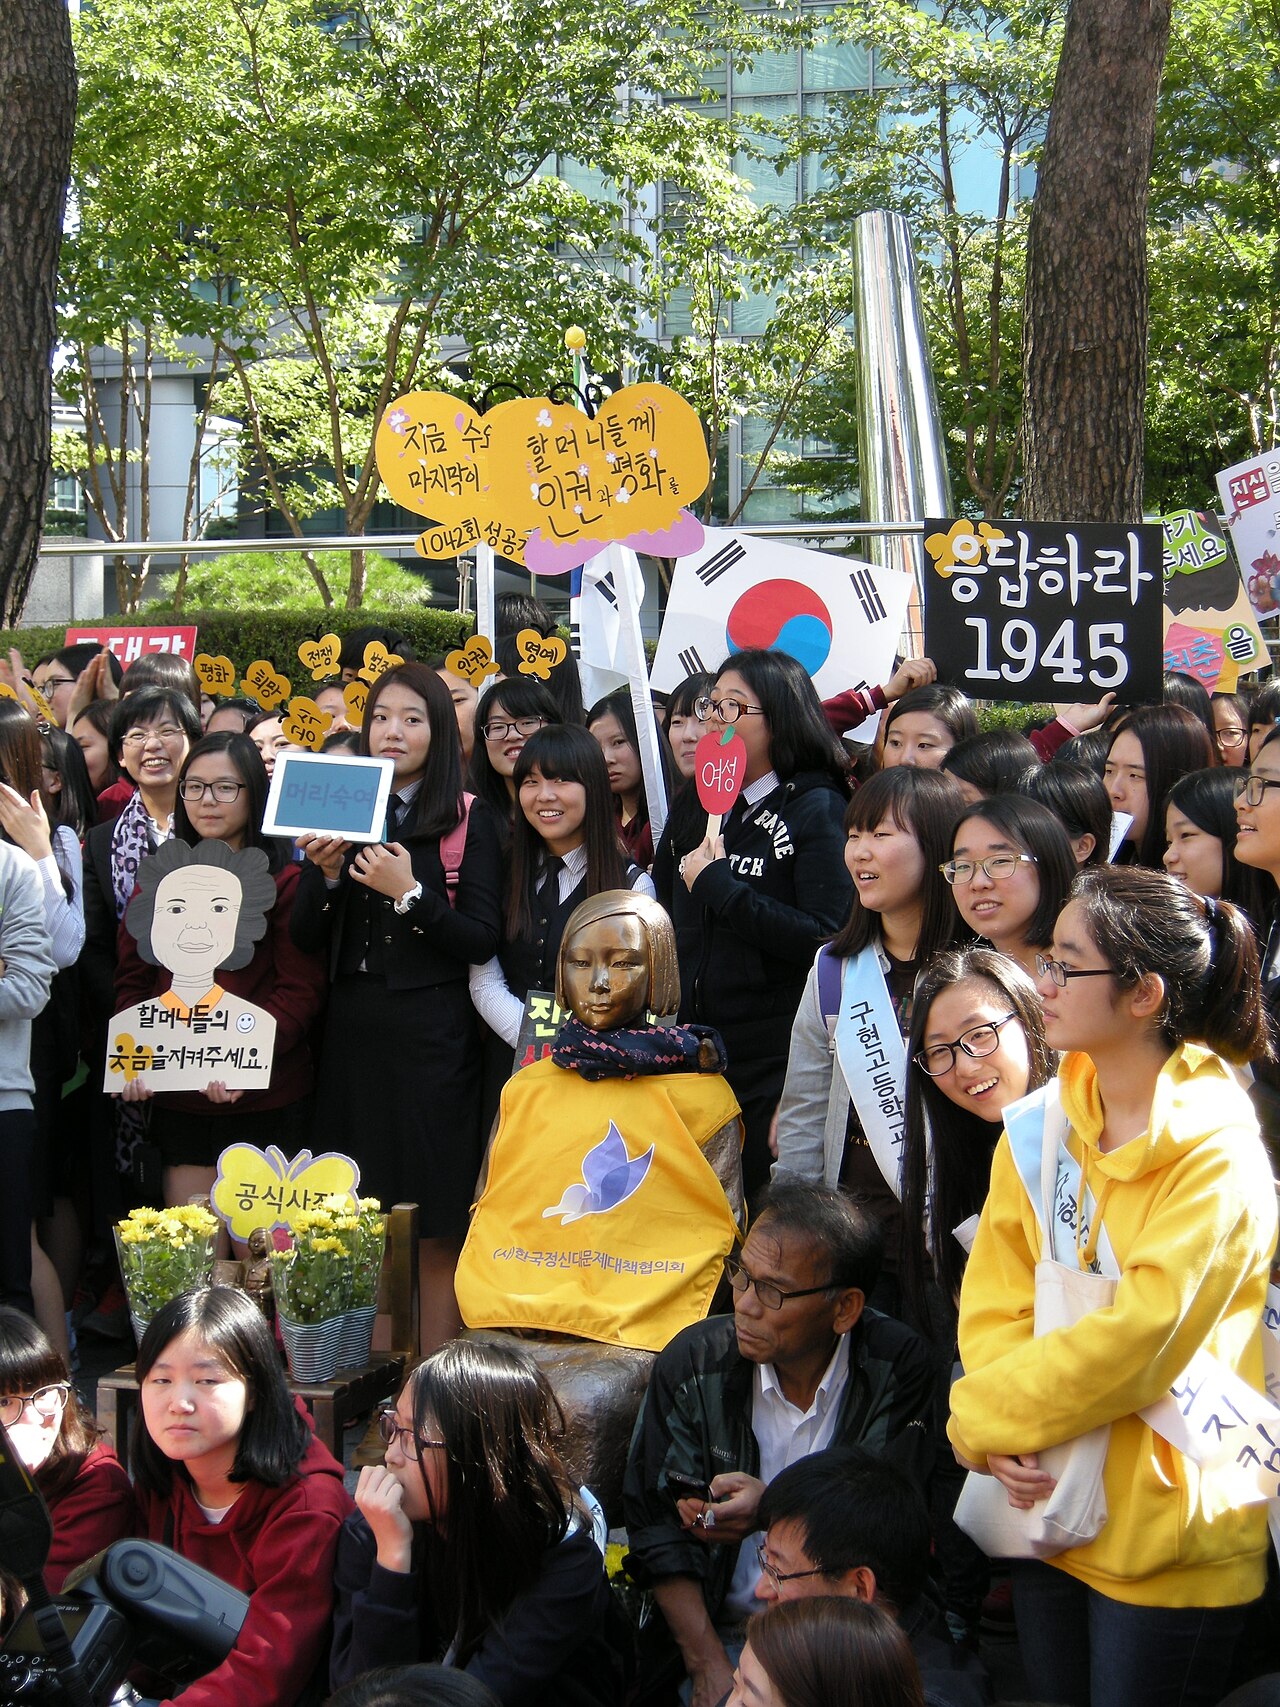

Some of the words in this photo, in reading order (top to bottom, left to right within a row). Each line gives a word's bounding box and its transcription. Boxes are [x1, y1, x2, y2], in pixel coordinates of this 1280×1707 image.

[403, 421, 447, 455] 지금
[944, 531, 1153, 608] 응답하라
[307, 644, 333, 669] 전쟁
[457, 647, 489, 676] 인권
[524, 641, 559, 664] 명예
[964, 617, 1129, 688] 1945
[199, 663, 230, 683] 평화
[250, 668, 282, 698] 희망
[701, 756, 738, 793] 여성
[137, 1003, 229, 1035] 할머니들의
